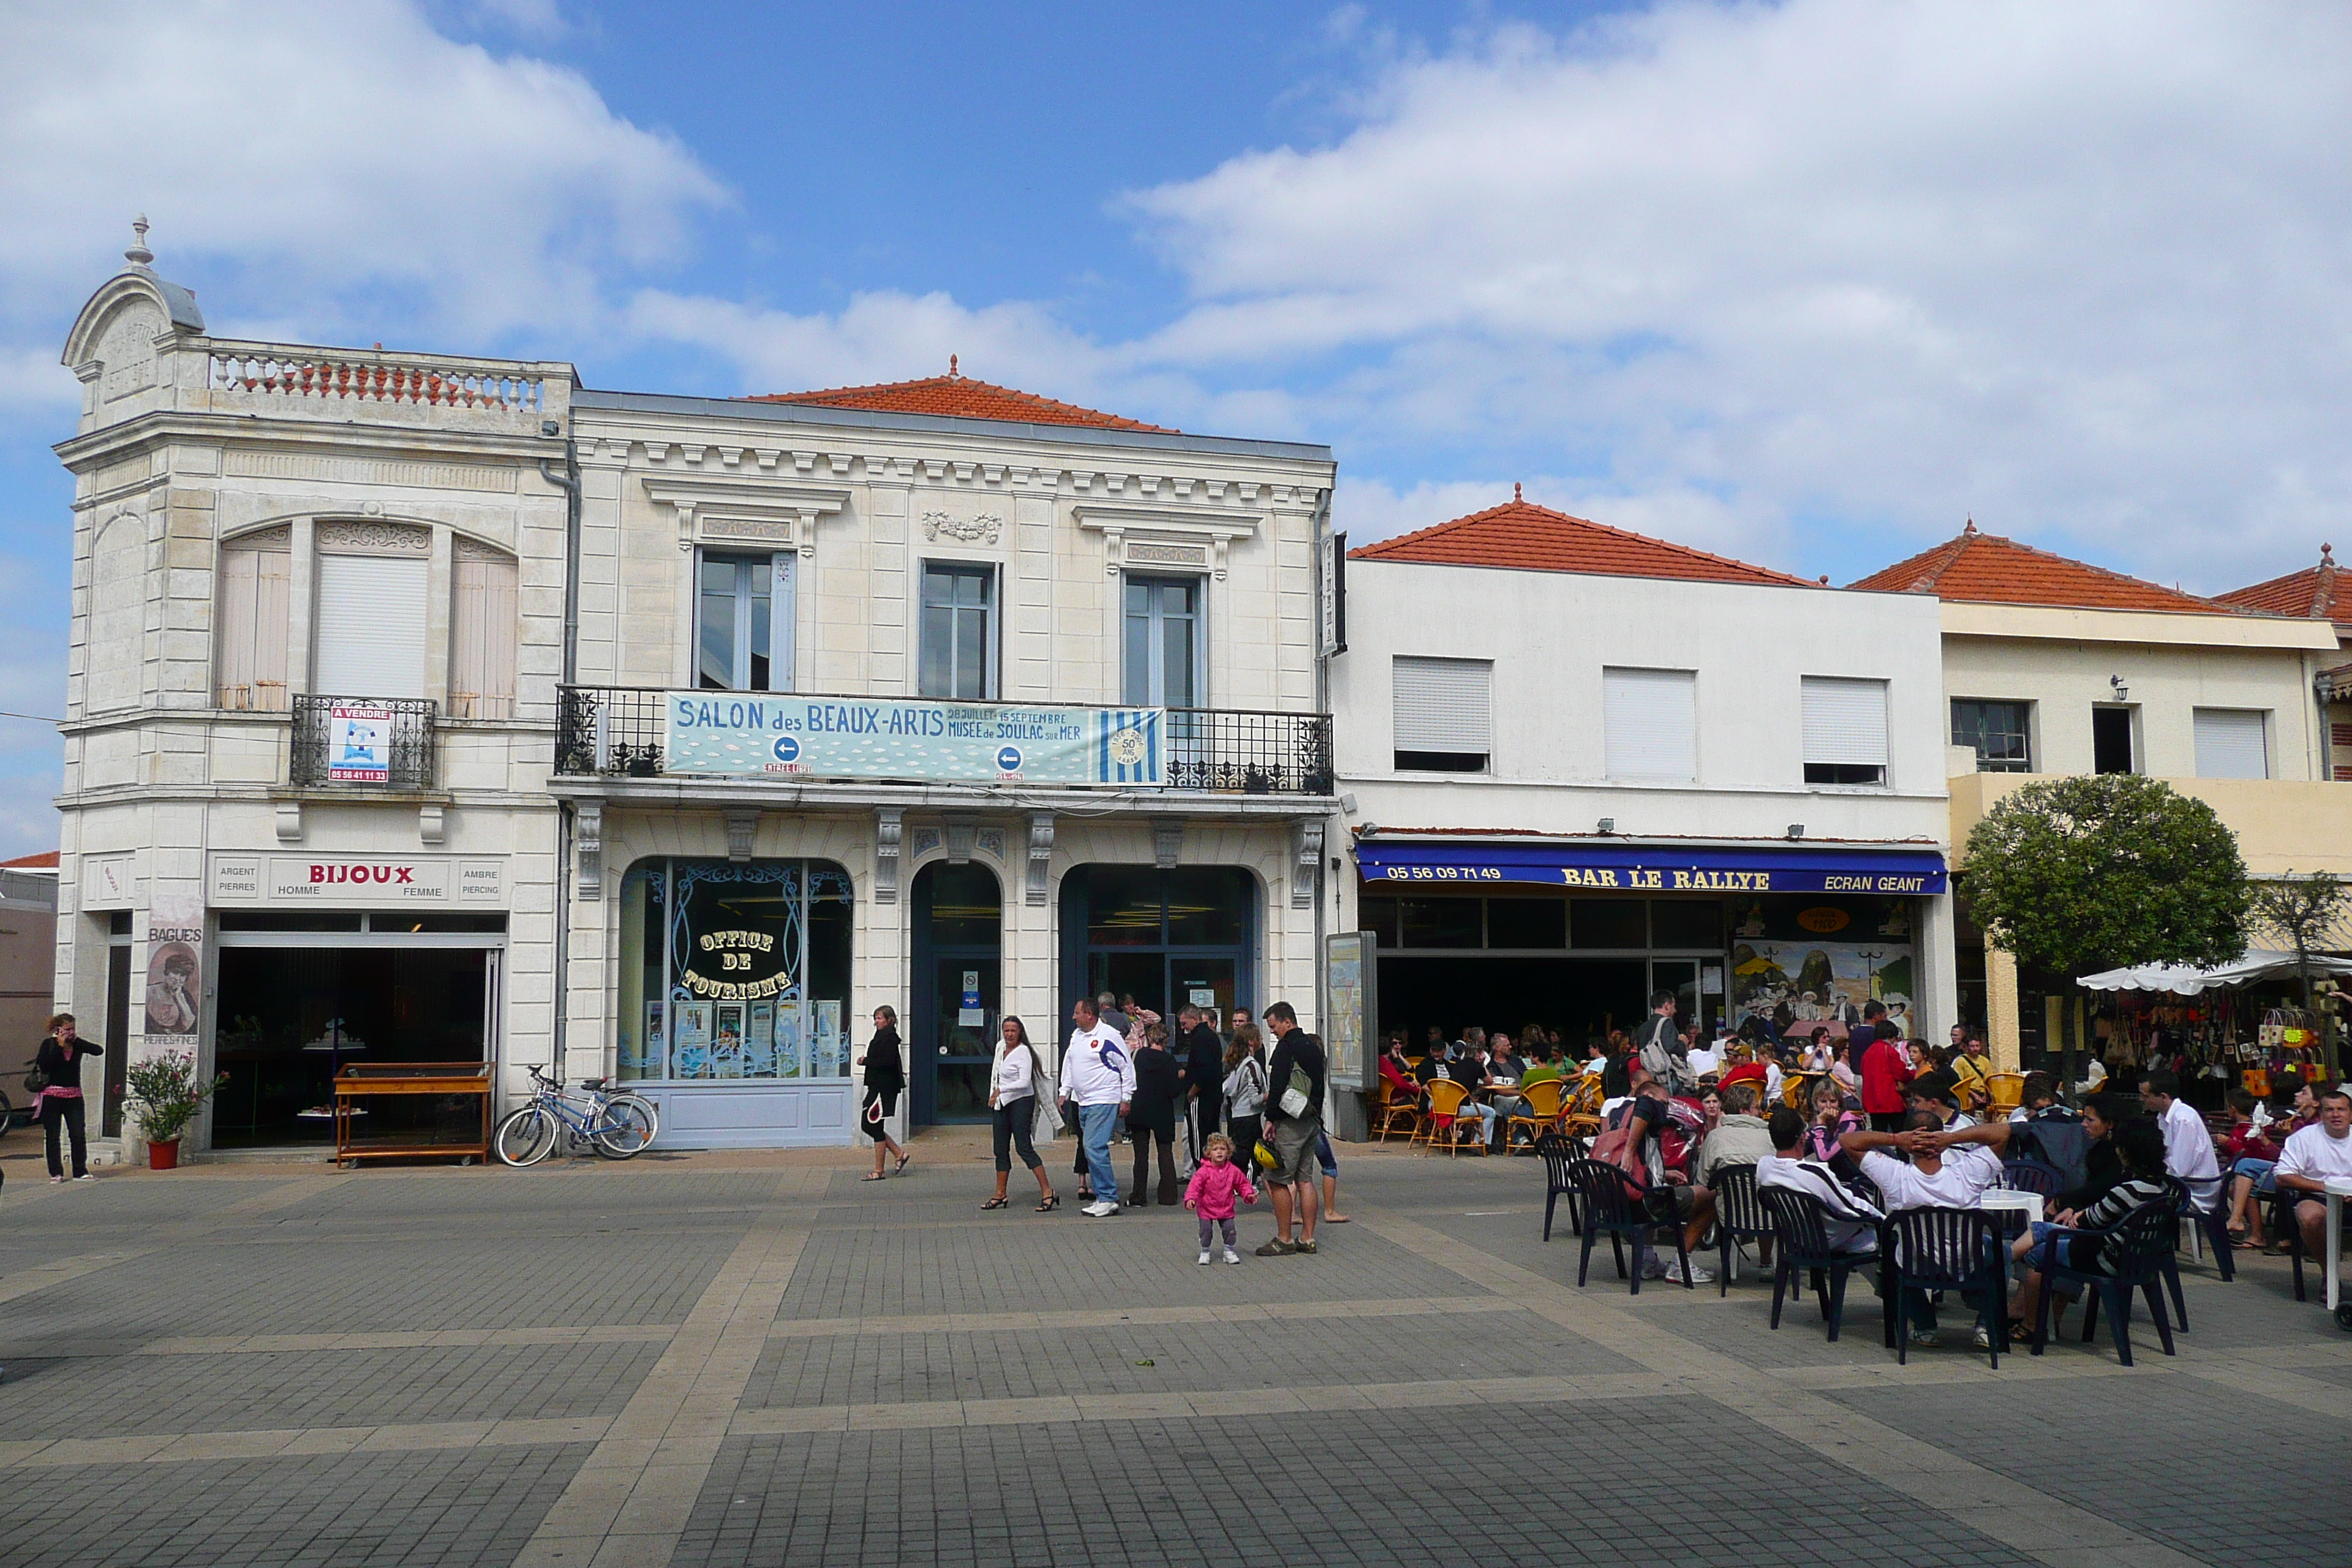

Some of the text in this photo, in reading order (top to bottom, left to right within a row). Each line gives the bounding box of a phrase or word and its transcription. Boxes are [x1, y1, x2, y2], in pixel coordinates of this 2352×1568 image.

[334, 709, 388, 719] A VENDRE
[676, 700, 944, 737] SALON des BEAUX-ARTS
[948, 709, 960, 719] 28
[1000, 712, 1009, 722] 15
[1010, 713, 1066, 724] SEPTEMBRE
[983, 728, 995, 739] de
[996, 723, 1044, 739] SOULAC
[1059, 725, 1081, 741] MER
[1122, 739, 1136, 748] 50
[1122, 748, 1135, 756] ANS
[331, 770, 386, 780] 05 56 41 11 33
[220, 867, 256, 876] ARGENT
[308, 864, 415, 884] BIJOUX
[463, 870, 498, 879] AMBRE
[1387, 867, 1501, 880] 05 56 09 71 49
[1561, 869, 1770, 890] BAR LE RALLYE
[1824, 876, 1925, 892] ECRAN GEANT
[219, 882, 256, 892] PIERRES
[278, 885, 442, 897] HOMME FEMME
[462, 886, 499, 894] PIERCING
[148, 927, 202, 942] BAGUES
[699, 930, 774, 953] OFFICE
[722, 953, 752, 970] DE
[681, 968, 792, 1000] TOURISME
